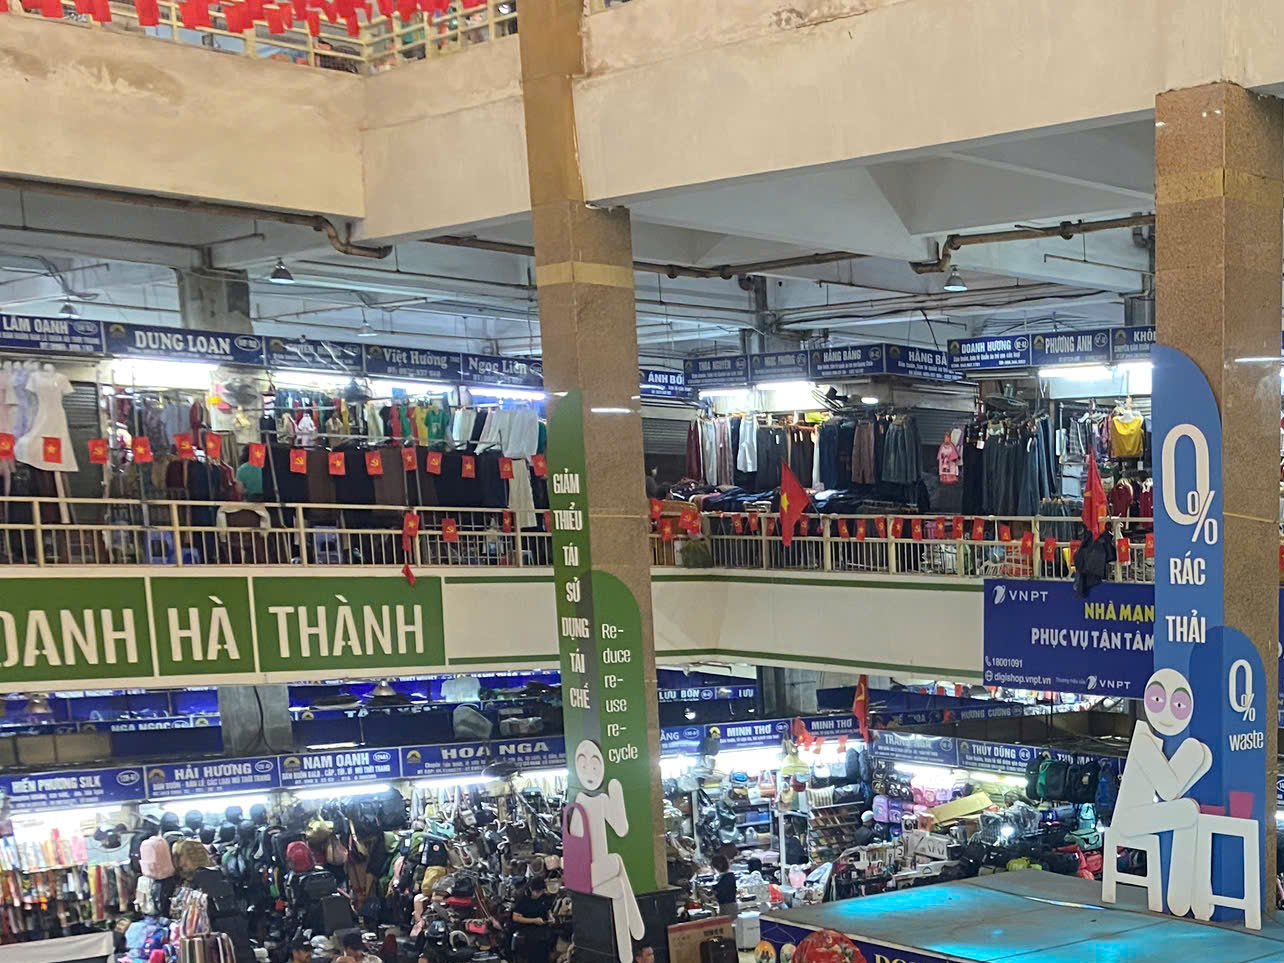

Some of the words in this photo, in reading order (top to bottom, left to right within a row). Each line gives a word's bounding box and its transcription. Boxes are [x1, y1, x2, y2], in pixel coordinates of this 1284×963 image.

[34, 319, 69, 335] OANH
[134, 330, 184, 351] DUNG
[187, 335, 231, 354] LOAN
[1045, 336, 1074, 353] PHƯƠNG
[1077, 335, 1092, 351] ANH
[383, 348, 408, 366] Việt
[468, 358, 498, 374] Ngọc
[553, 468, 579, 494] GIẢM
[1161, 423, 1219, 546] 0%
[562, 543, 578, 567] TÁI
[1169, 550, 1206, 585] RÁC
[1008, 590, 1048, 603] VNPT
[1084, 602, 1115, 621] NHÀ
[168, 595, 240, 662] HÀ
[268, 594, 425, 659] THÀNH
[562, 617, 590, 640] DỤNG
[602, 623, 624, 639] Re-
[1165, 609, 1206, 644] THẢI
[1031, 628, 1068, 649] PHỤC
[1069, 630, 1088, 649] VỤ
[1090, 627, 1122, 651] TẬN
[1124, 630, 1155, 651] TÂM
[569, 648, 585, 673] TÁI
[603, 647, 631, 664] duce
[992, 657, 1023, 668] 18001091
[605, 675, 624, 688] re-
[994, 672, 1052, 685] digishop.vnpt.vn
[1099, 679, 1131, 689] VNPT
[570, 683, 591, 709] CHẾ
[1228, 659, 1256, 722] 0%
[606, 698, 627, 713] use
[607, 723, 627, 737] re-
[727, 725, 752, 737] MINH
[754, 723, 772, 735] THƠ
[811, 720, 834, 730] MINH
[836, 718, 852, 728] THƠ
[1229, 730, 1264, 751] waste
[441, 746, 490, 760] HOA
[499, 742, 549, 755] NGA
[608, 743, 638, 763] cycle
[993, 745, 1016, 759] DŨNG
[303, 756, 333, 770] NAM
[336, 752, 369, 767] OANH
[174, 765, 199, 780] HẢI
[203, 763, 252, 778] HƯƠNG
[79, 775, 101, 788] SILK
